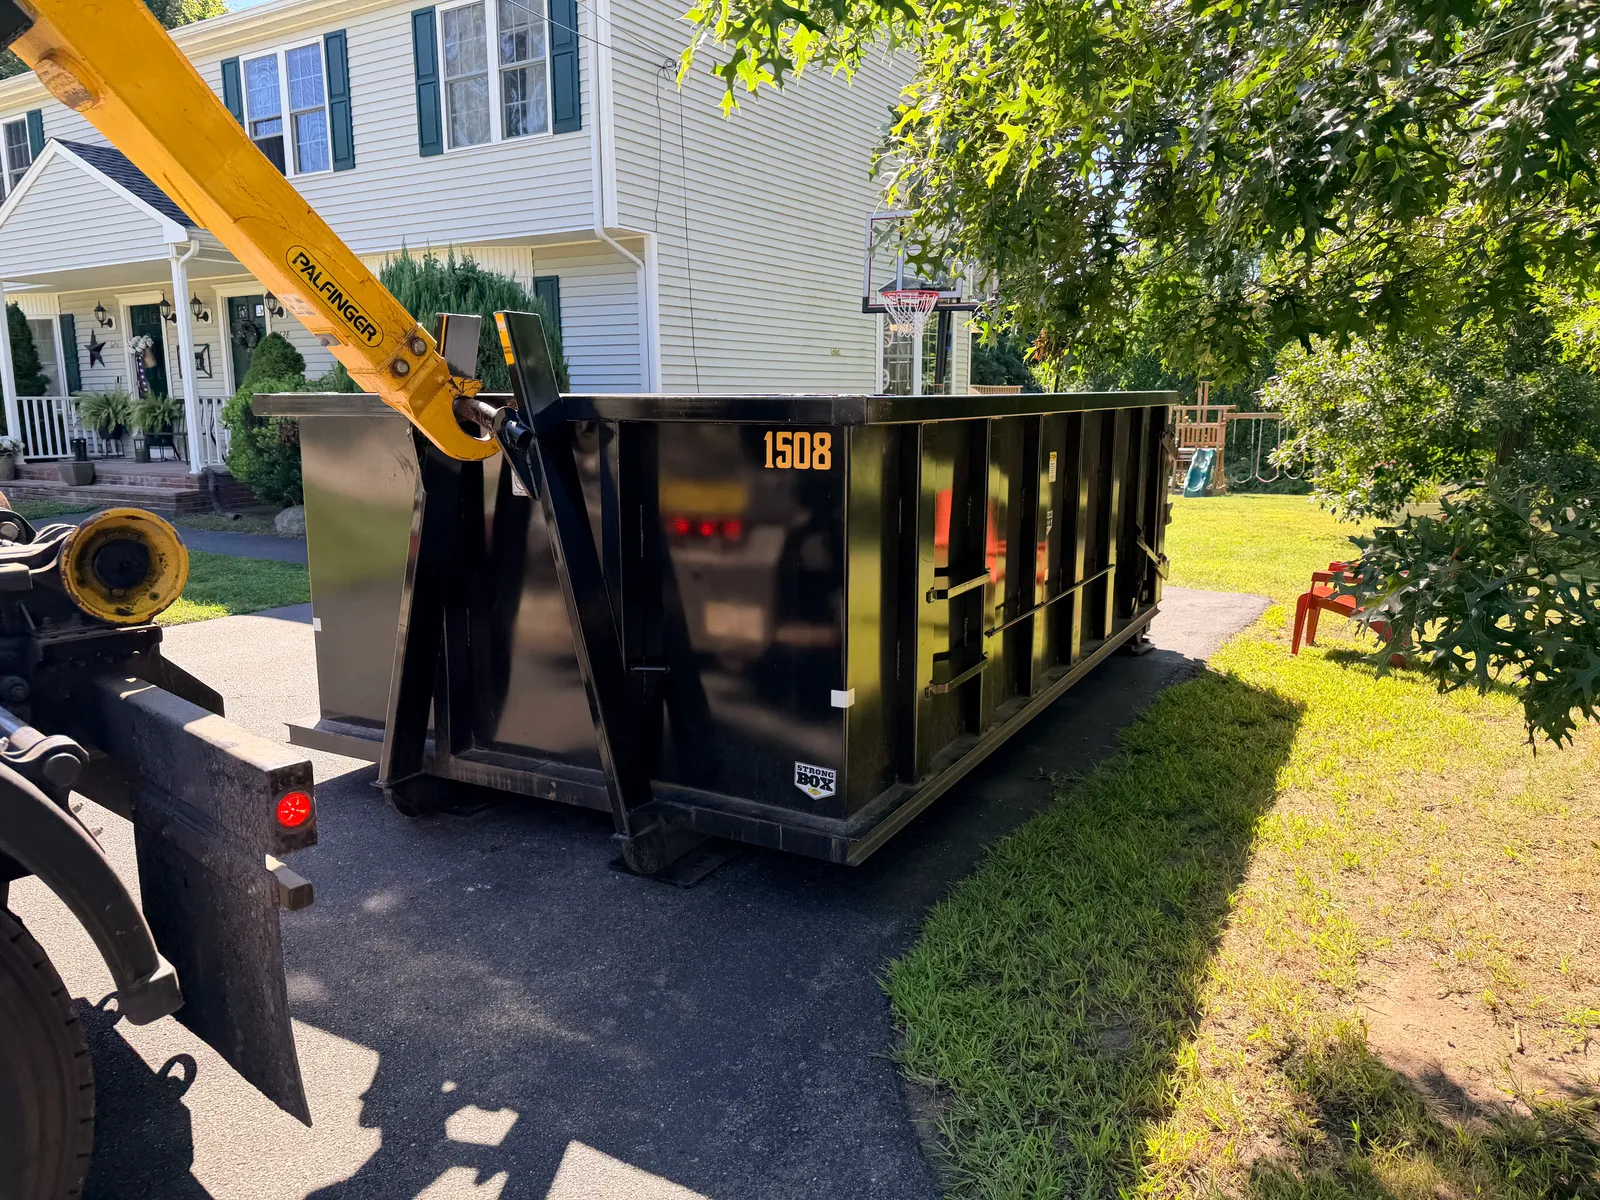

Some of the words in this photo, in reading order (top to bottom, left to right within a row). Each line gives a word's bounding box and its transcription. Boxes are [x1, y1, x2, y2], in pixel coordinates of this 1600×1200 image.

[291, 251, 377, 342] PALFINGER
[763, 431, 832, 470] 1508
[796, 771, 834, 792] BOX
[797, 764, 834, 779] STRONG
